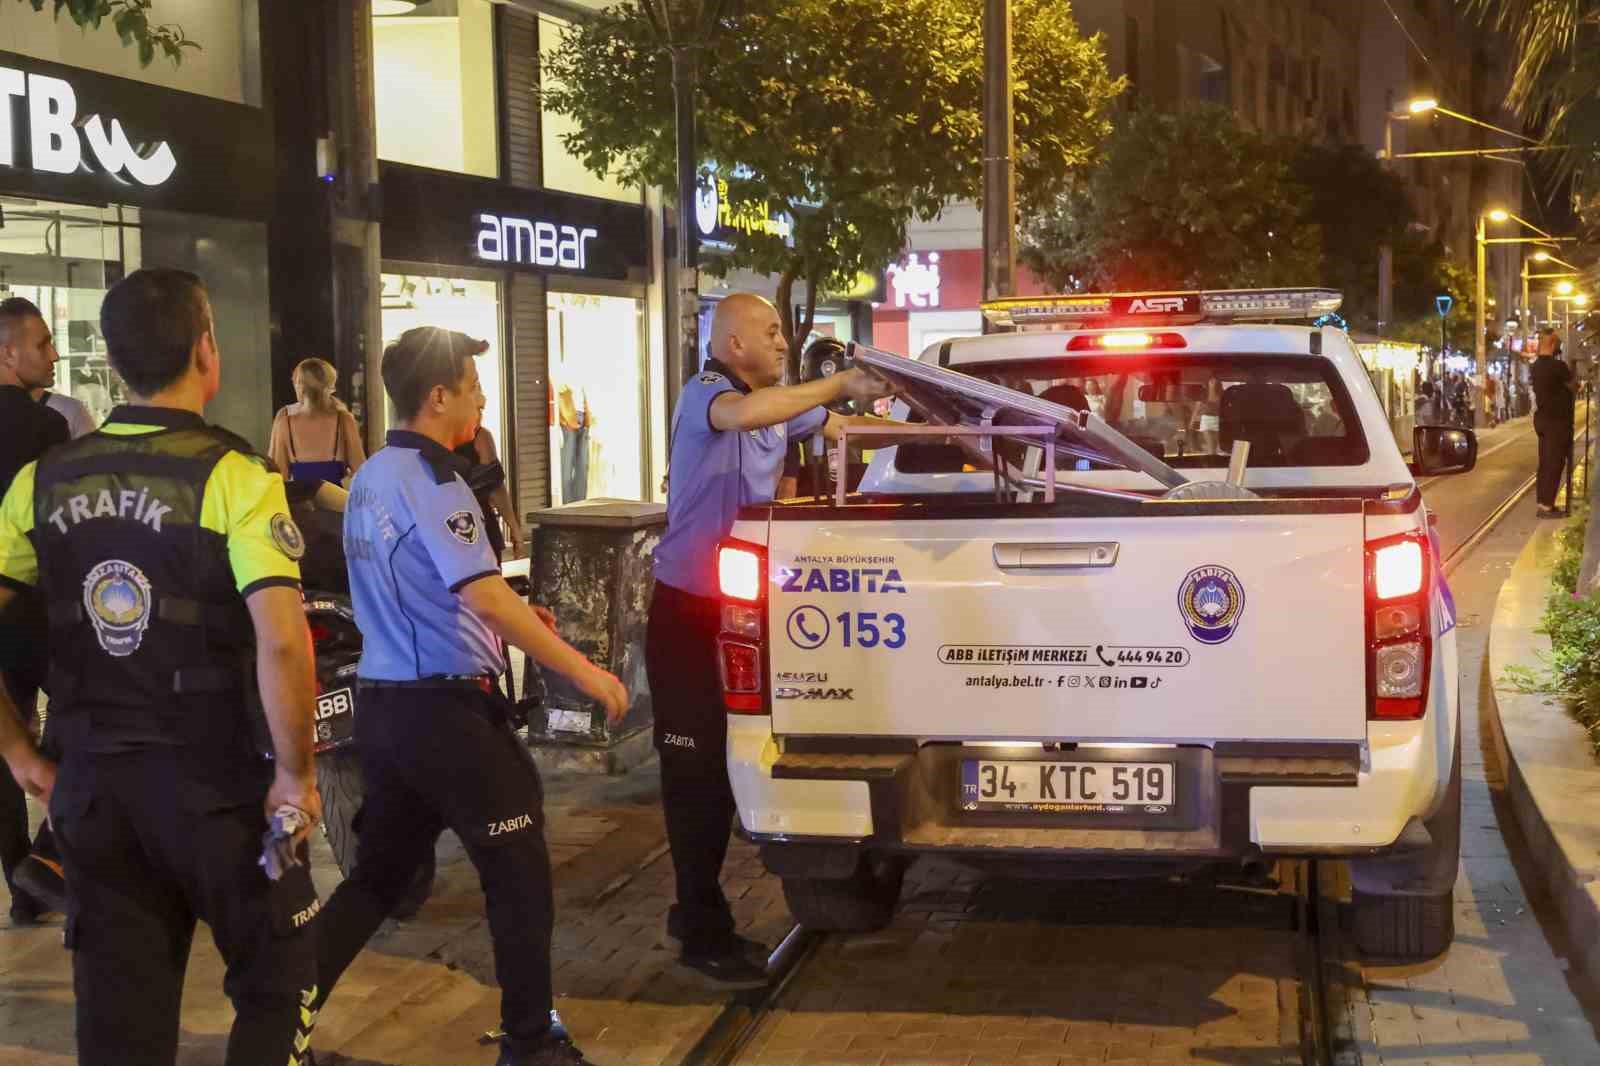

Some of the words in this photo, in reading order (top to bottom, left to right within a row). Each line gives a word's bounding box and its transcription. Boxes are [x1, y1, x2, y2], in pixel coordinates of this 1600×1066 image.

[1127, 297, 1184, 313] ASR
[49, 486, 173, 535] TRAFİK
[780, 568, 907, 593] ZABITA
[1193, 568, 1230, 583] ZABITA
[836, 611, 906, 649] 153
[946, 648, 974, 661] ABB
[1117, 650, 1142, 662] 444
[1146, 651, 1162, 663] 94
[1165, 651, 1182, 663] 20
[776, 671, 829, 683] ISUZU
[965, 674, 1044, 689] antalya.bel.tr
[775, 687, 855, 701] D-MAX
[314, 694, 349, 721] BB
[663, 733, 696, 748] ZABITA
[963, 784, 977, 794] TR
[981, 765, 1016, 798] 34
[1039, 766, 1096, 800] KTC
[1112, 767, 1164, 801] 519
[487, 814, 533, 836] ZABITA
